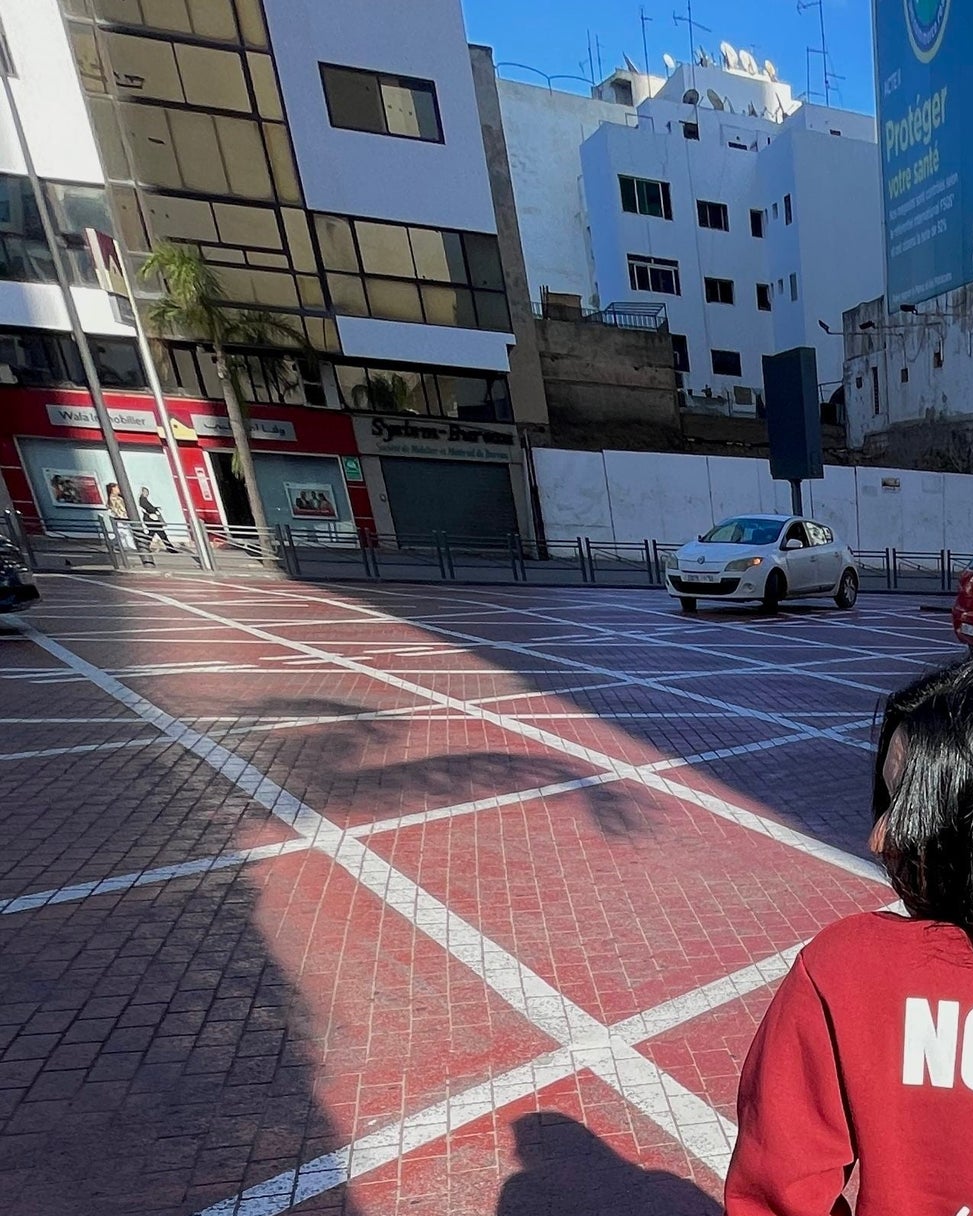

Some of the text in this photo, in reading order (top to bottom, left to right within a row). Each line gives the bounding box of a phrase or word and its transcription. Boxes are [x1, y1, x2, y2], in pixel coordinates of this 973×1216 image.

[885, 85, 948, 162] Protéger
[887, 164, 911, 200] votre
[913, 143, 940, 185] santé
